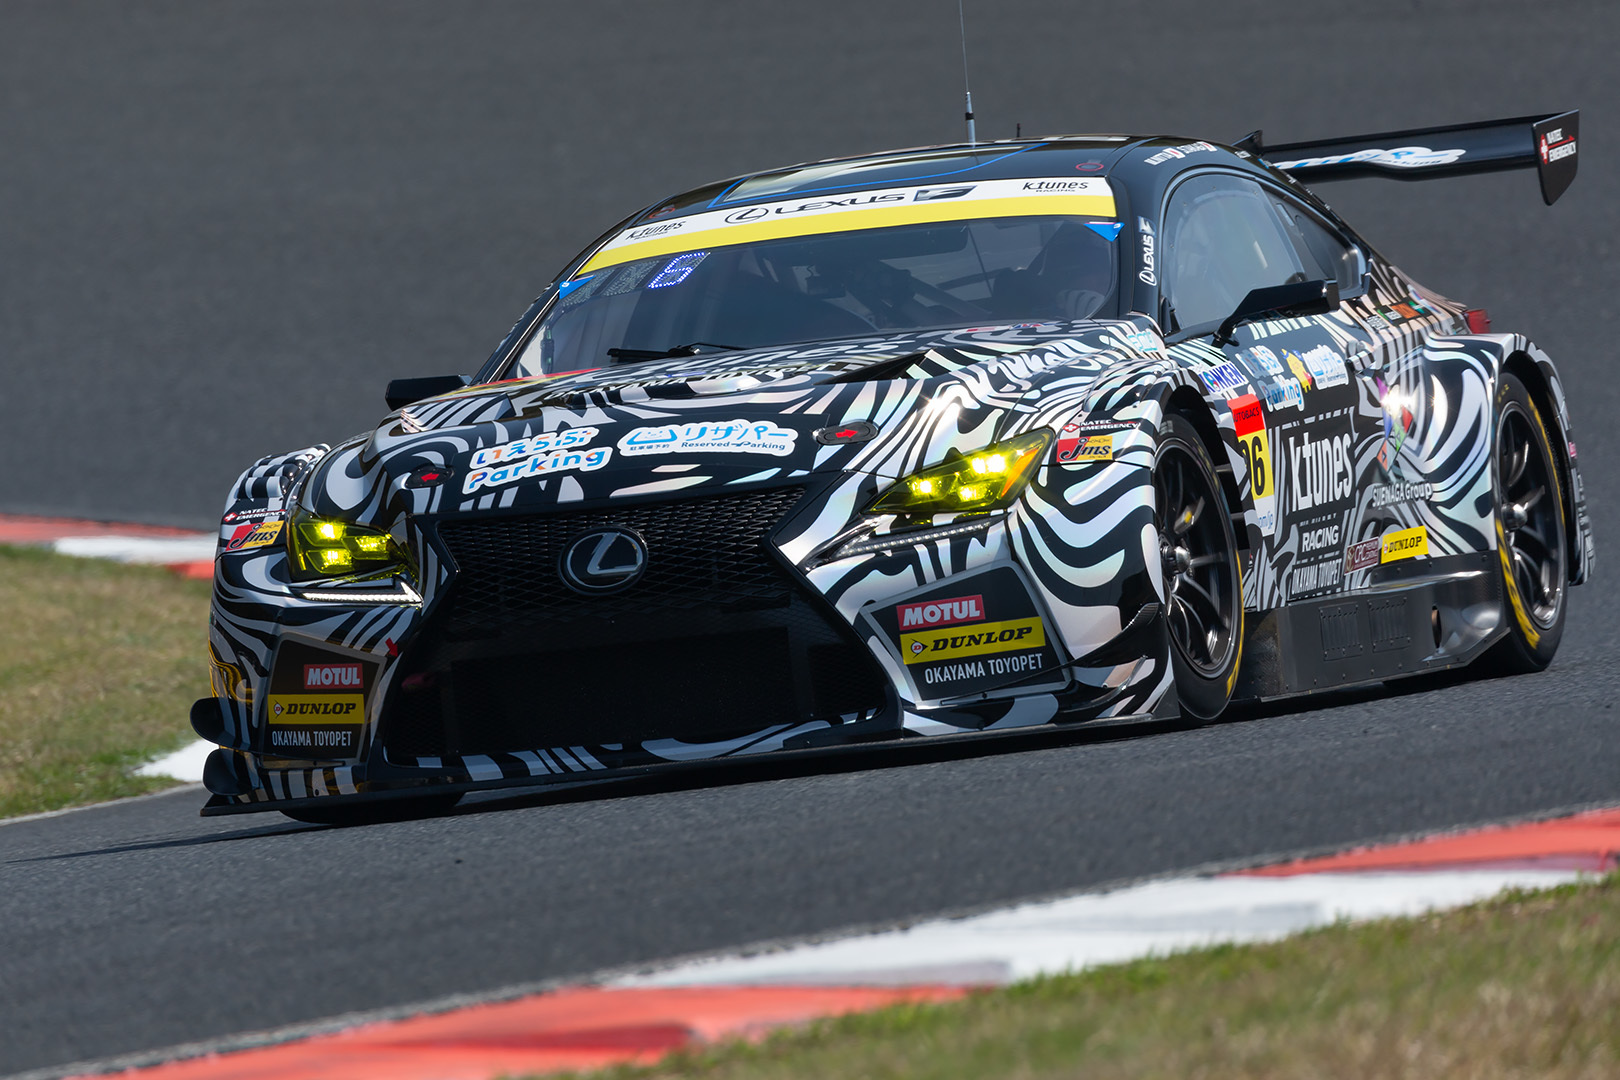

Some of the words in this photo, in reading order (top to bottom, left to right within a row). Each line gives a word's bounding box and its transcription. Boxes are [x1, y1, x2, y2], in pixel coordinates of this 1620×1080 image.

[774, 193, 905, 214] LEXUS
[1143, 234, 1154, 271] LEXUS
[1080, 419, 1112, 427] NATEC
[1233, 407, 1260, 422] UTOBACS
[1080, 422, 1141, 432] EMERGENCY
[469, 450, 606, 490] Parking
[1372, 482, 1406, 508] SUENAGA
[1405, 482, 1433, 500] Group
[236, 511, 286, 521] EMERGENCY
[240, 507, 267, 515] NATEC
[1302, 525, 1339, 552] RACING
[1388, 535, 1422, 553] DUNLOP
[903, 600, 980, 627] MOTUL
[931, 627, 1032, 651] DUNLOP
[307, 667, 361, 686] MOTUL
[925, 661, 986, 684] OKAYAMA
[988, 653, 1043, 675] TOYOPET
[286, 703, 356, 715] DUNLOP
[272, 731, 311, 746] OKAYAMA
[313, 731, 352, 746] TOYOPET
